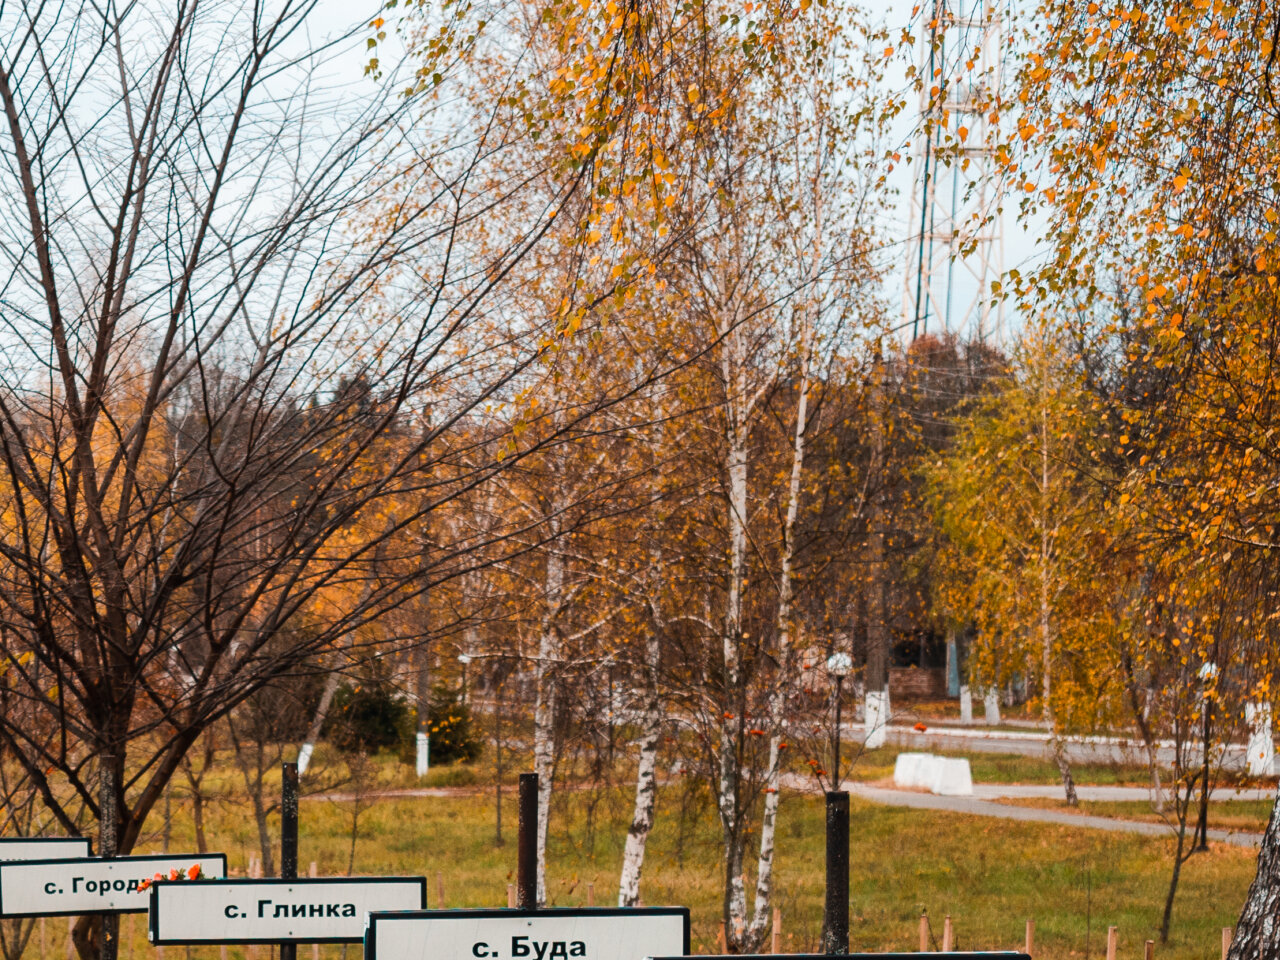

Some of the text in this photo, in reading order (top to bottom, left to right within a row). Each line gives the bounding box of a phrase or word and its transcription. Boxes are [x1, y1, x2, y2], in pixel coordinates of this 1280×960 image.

[44, 876, 146, 896] с. Город
[224, 899, 357, 919] с. Глинка
[472, 941, 499, 958] с.
